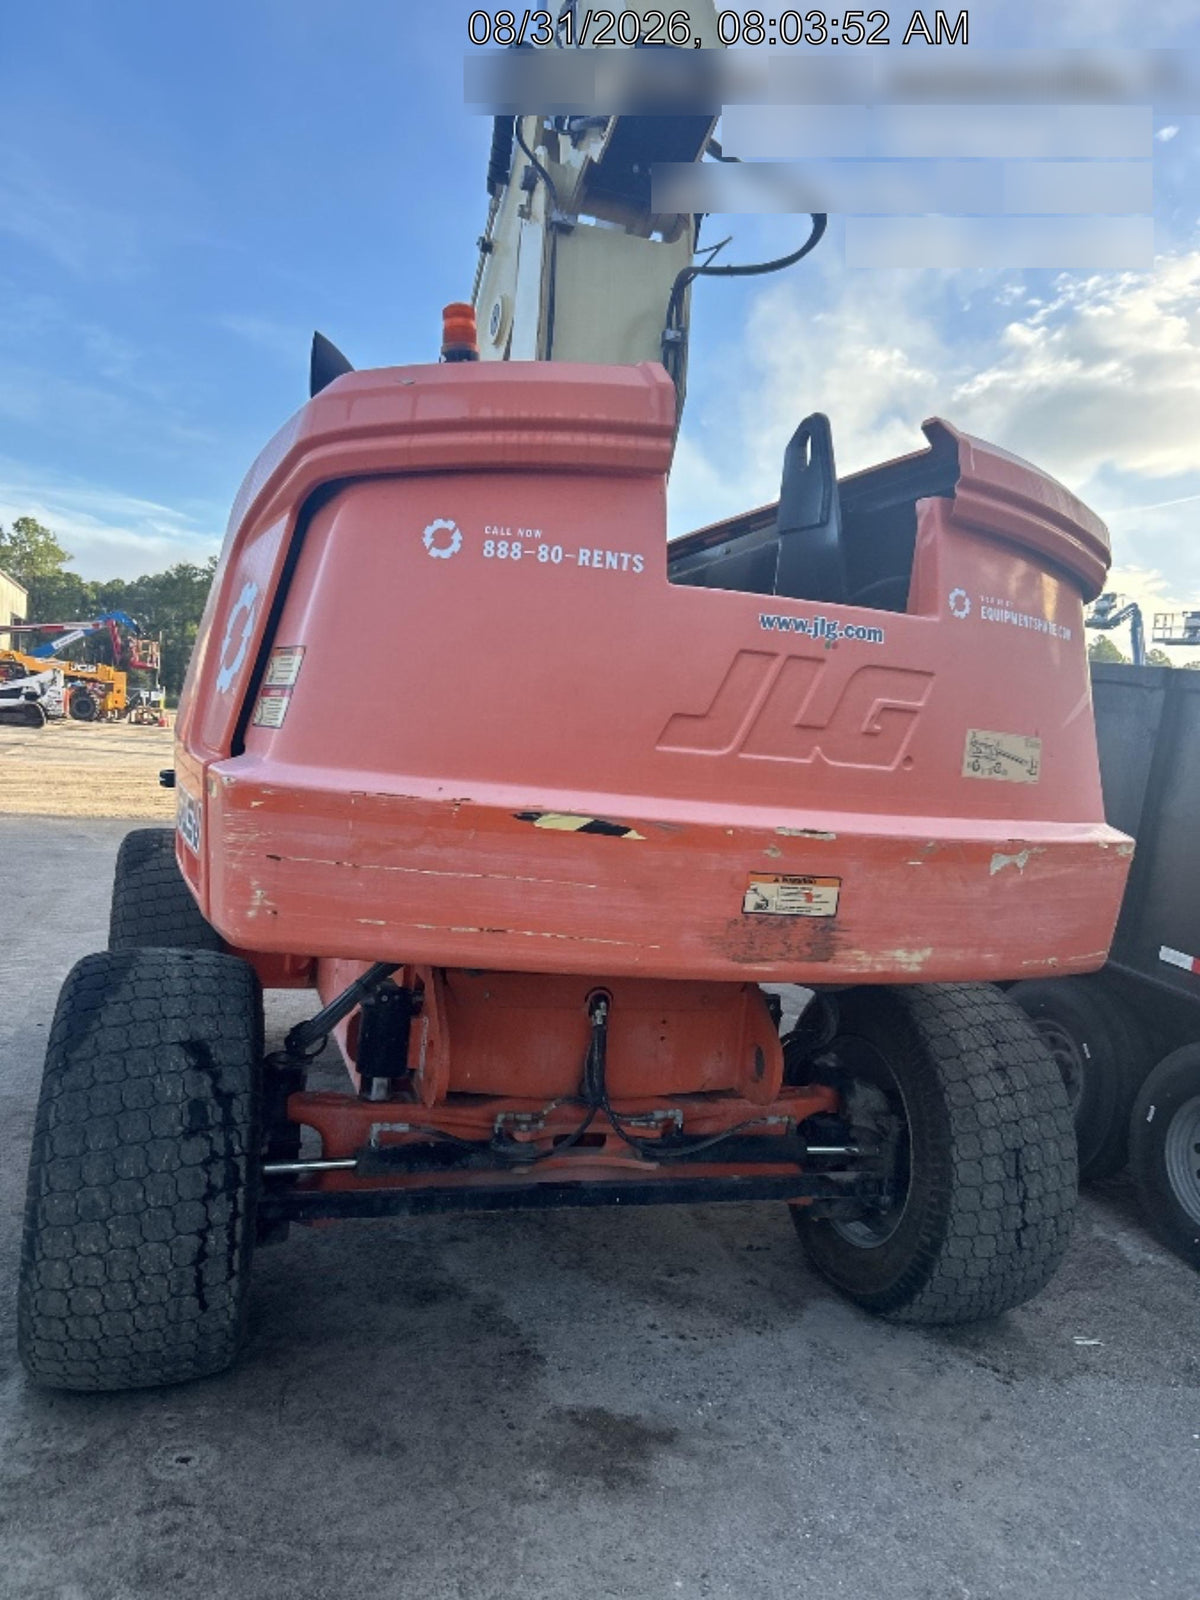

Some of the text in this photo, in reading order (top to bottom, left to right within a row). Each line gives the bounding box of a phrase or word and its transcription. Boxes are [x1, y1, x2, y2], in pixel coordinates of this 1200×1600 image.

[484, 525, 543, 539] CALL NOW
[482, 540, 645, 574] 888-80-RENTS
[758, 612, 885, 645] www.jlg.com
[655, 648, 936, 771] JLG
